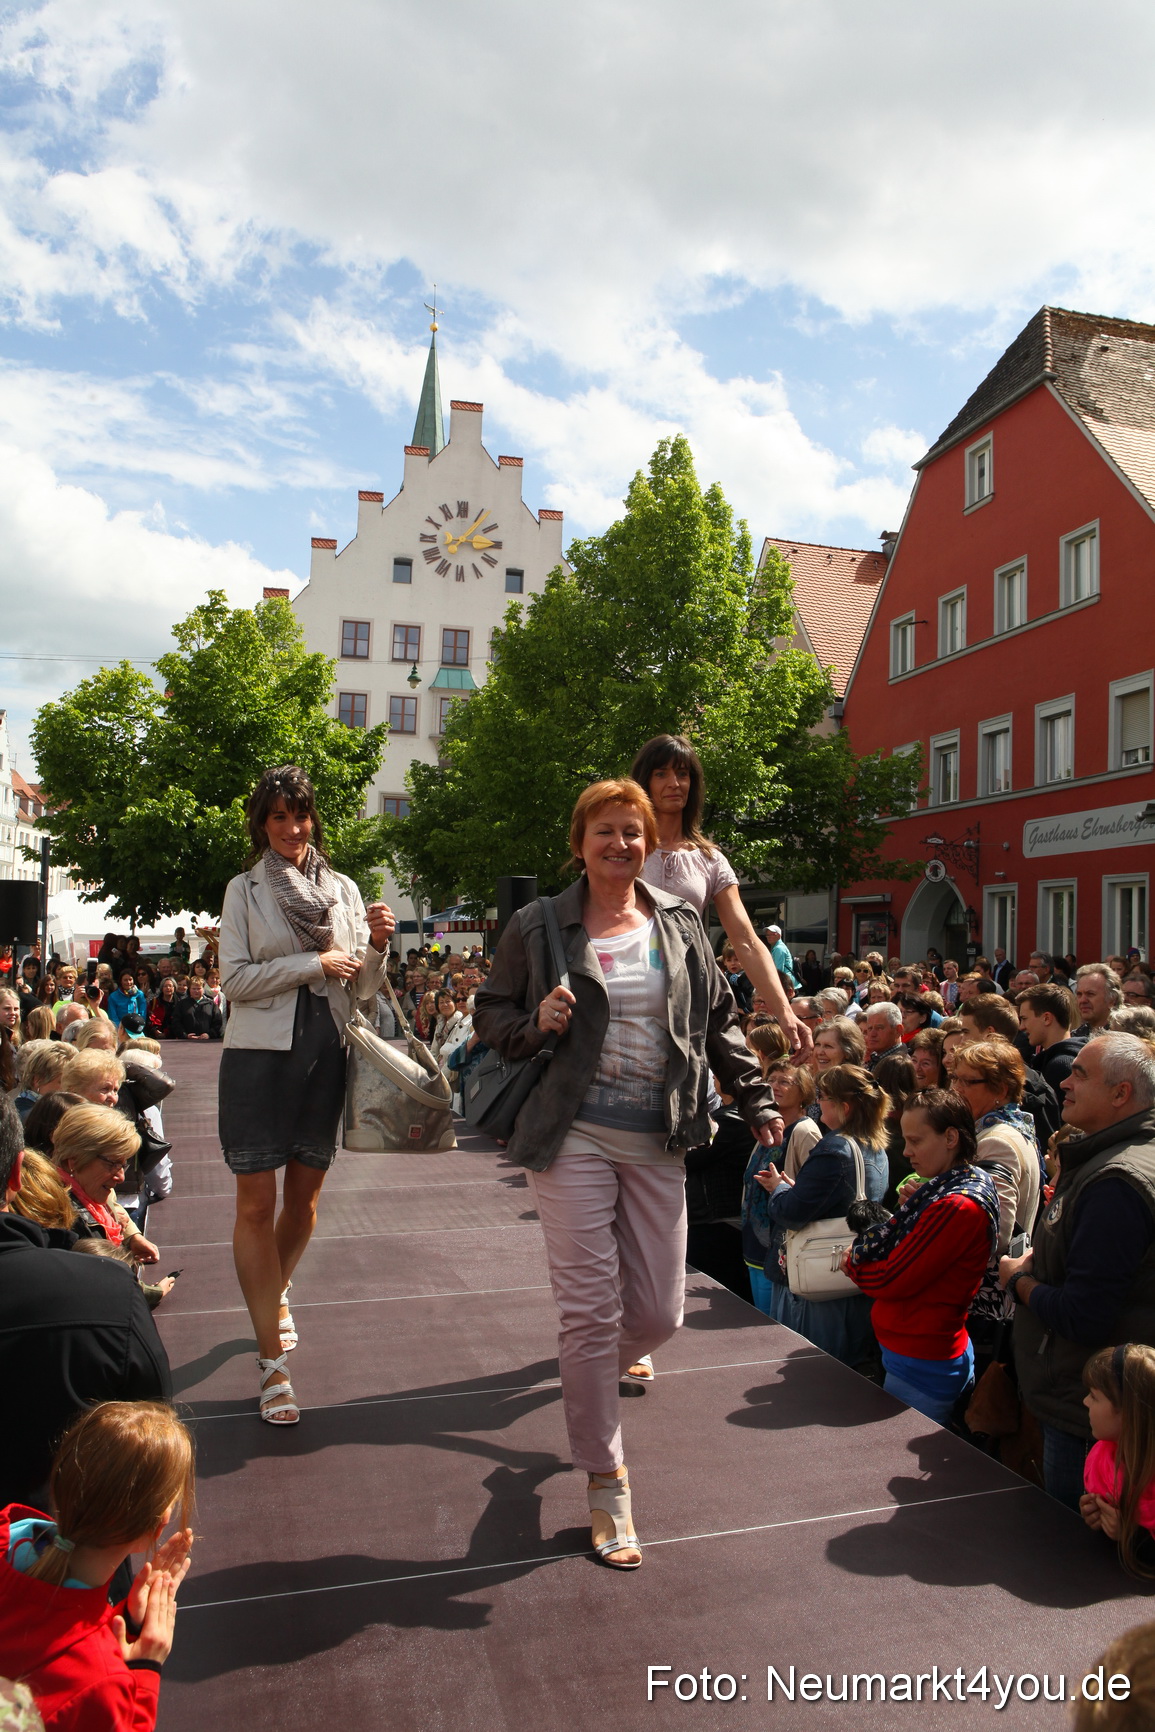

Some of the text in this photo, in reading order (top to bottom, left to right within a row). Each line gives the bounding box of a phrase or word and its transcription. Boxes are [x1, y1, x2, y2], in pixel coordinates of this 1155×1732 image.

[438, 503, 454, 522] XI
[456, 501, 469, 519] XII
[425, 515, 442, 530] X
[482, 523, 499, 534] II
[455, 565, 465, 582] VI
[472, 563, 483, 579] V
[1028, 823, 1079, 852] Gasthaus
